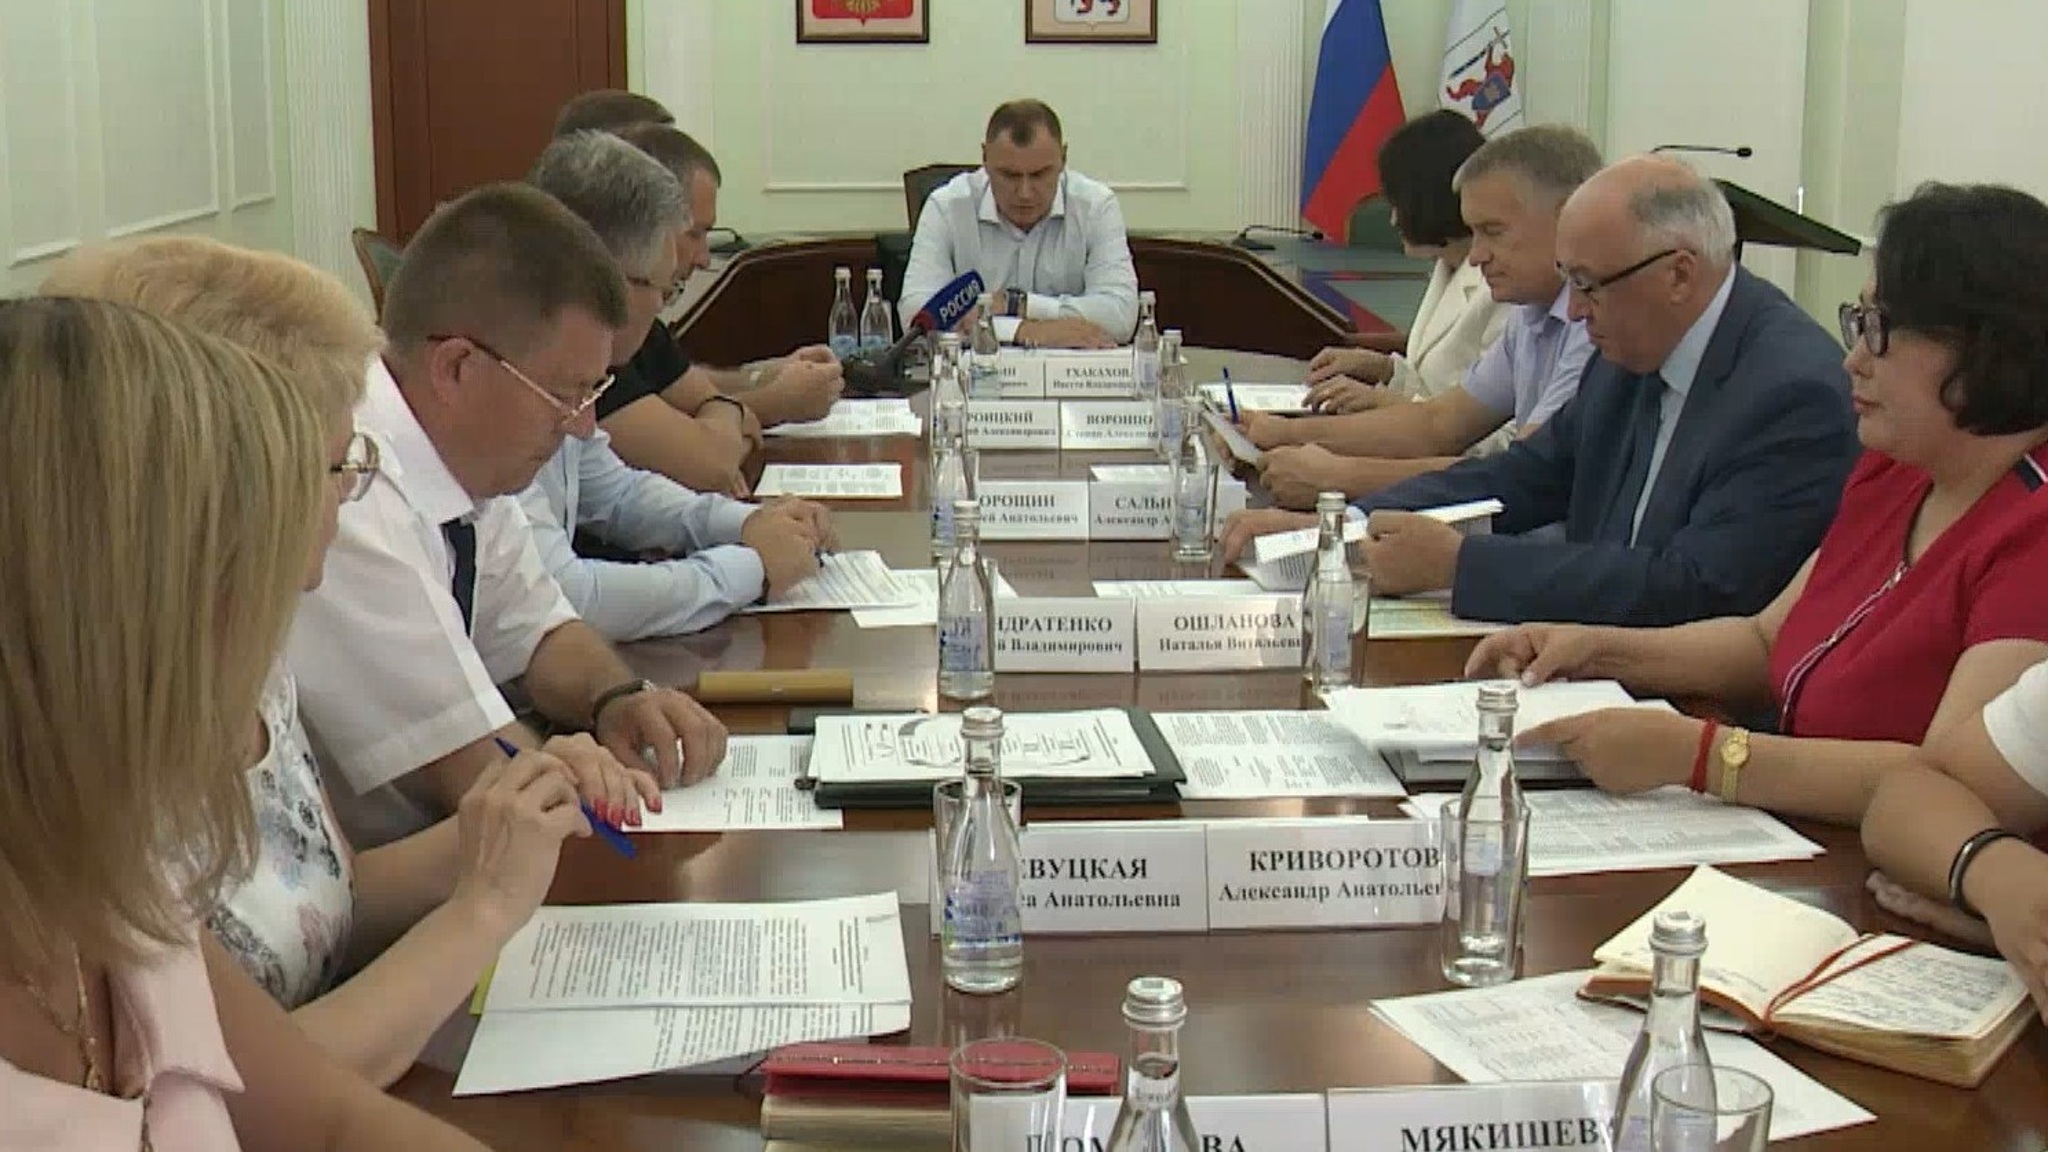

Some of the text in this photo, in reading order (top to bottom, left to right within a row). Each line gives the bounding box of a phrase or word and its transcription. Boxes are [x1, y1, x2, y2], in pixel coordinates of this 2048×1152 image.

[938, 279, 981, 325] РОССИЯ
[1066, 367, 1132, 378] ТХАКАХОВ
[967, 410, 1034, 425] РОИЦКИЙ
[1086, 414, 1154, 425] ВОРОНЦО
[979, 494, 1055, 509] ОРОЩИН
[1114, 497, 1172, 510] САЛЬН
[1001, 513, 1079, 525] Анатольевич
[1173, 612, 1296, 632] ОШЛАНОВА
[1011, 637, 1123, 656] Владимирович
[1158, 635, 1301, 652] Наталья Витальев
[1249, 846, 1440, 872] КРИВОРОТОВ
[1044, 890, 1182, 908] Анатольевна
[1218, 882, 1332, 904] Александр
[1400, 1116, 1607, 1152] МЯКИШЕВ
